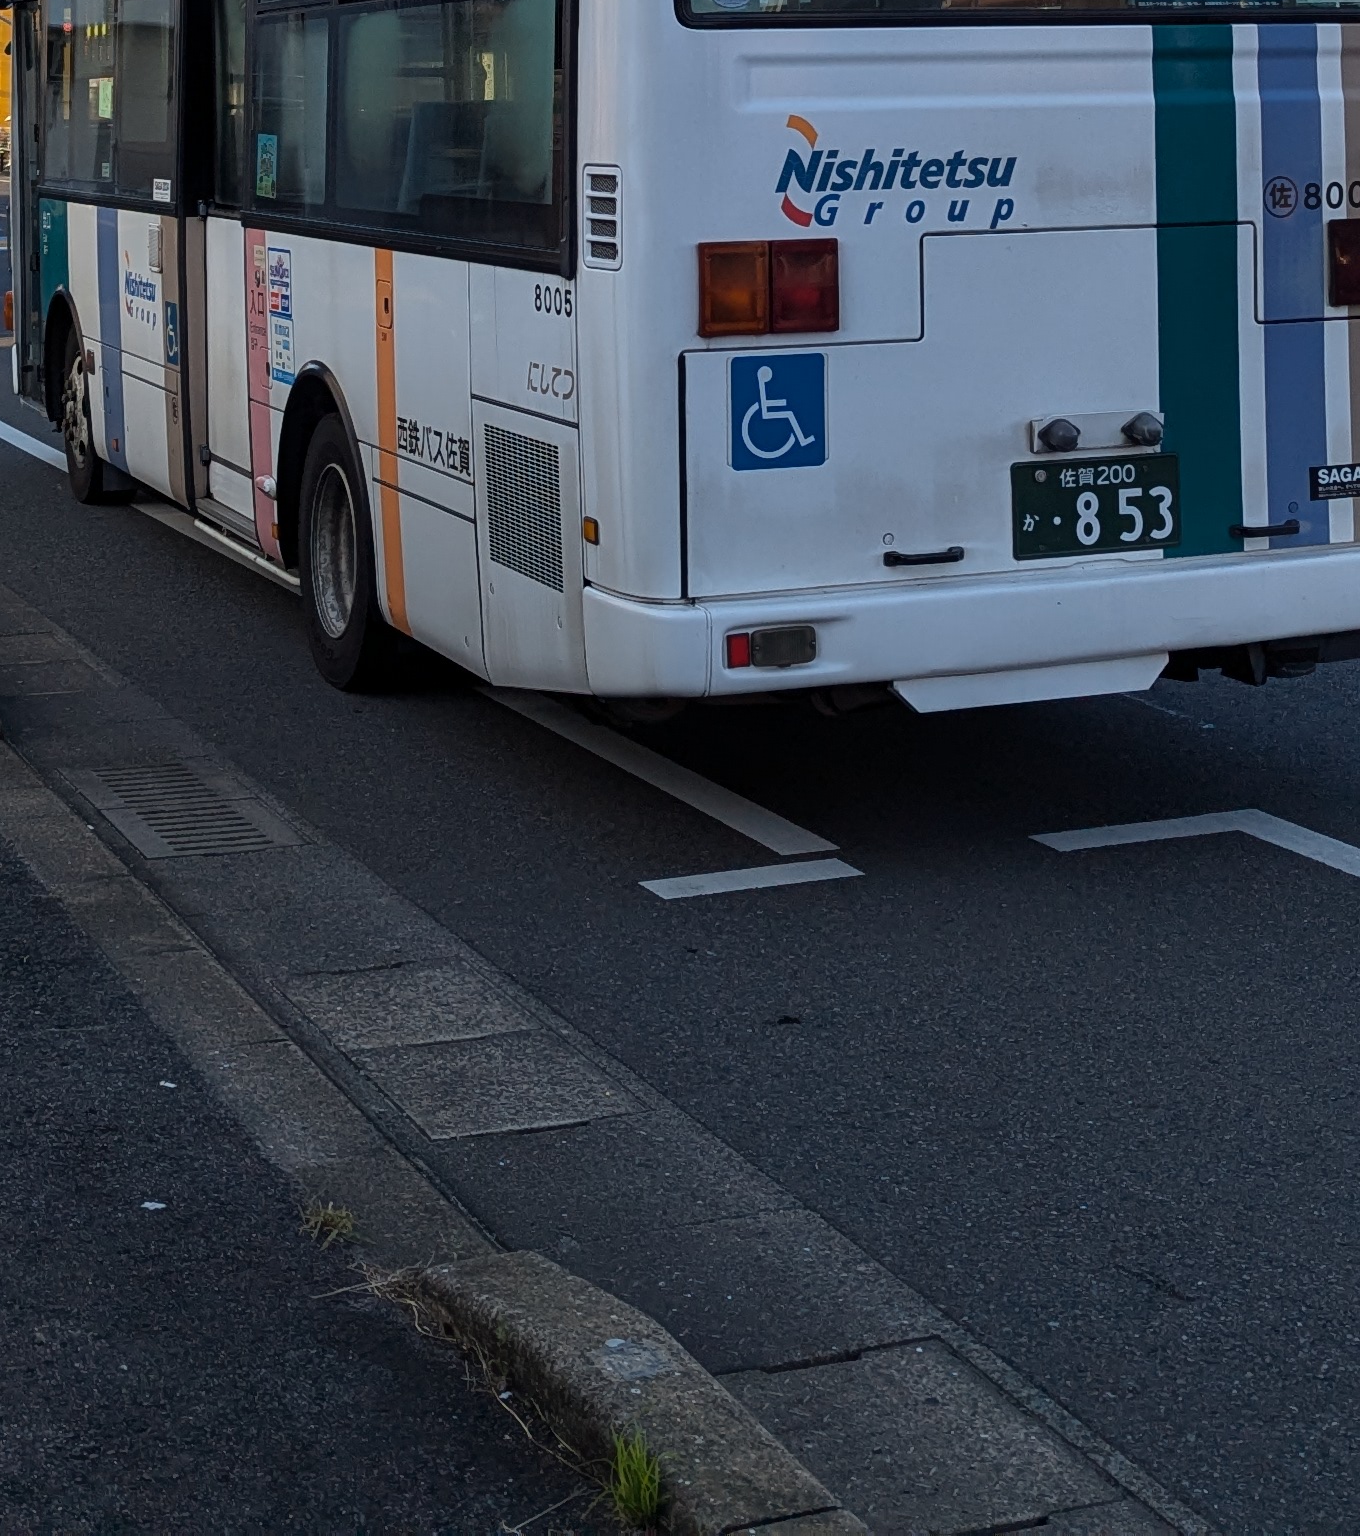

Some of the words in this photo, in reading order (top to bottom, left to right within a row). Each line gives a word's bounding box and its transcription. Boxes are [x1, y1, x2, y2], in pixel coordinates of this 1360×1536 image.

[775, 148, 1018, 193] Nishitetsu
[814, 194, 1016, 229] Group
[124, 270, 156, 303] Nishitetsu
[534, 284, 573, 318] 8005
[527, 361, 575, 400] にしてつ
[397, 417, 471, 476] 西鉄バス佐賀
[1022, 512, 1040, 532] か
